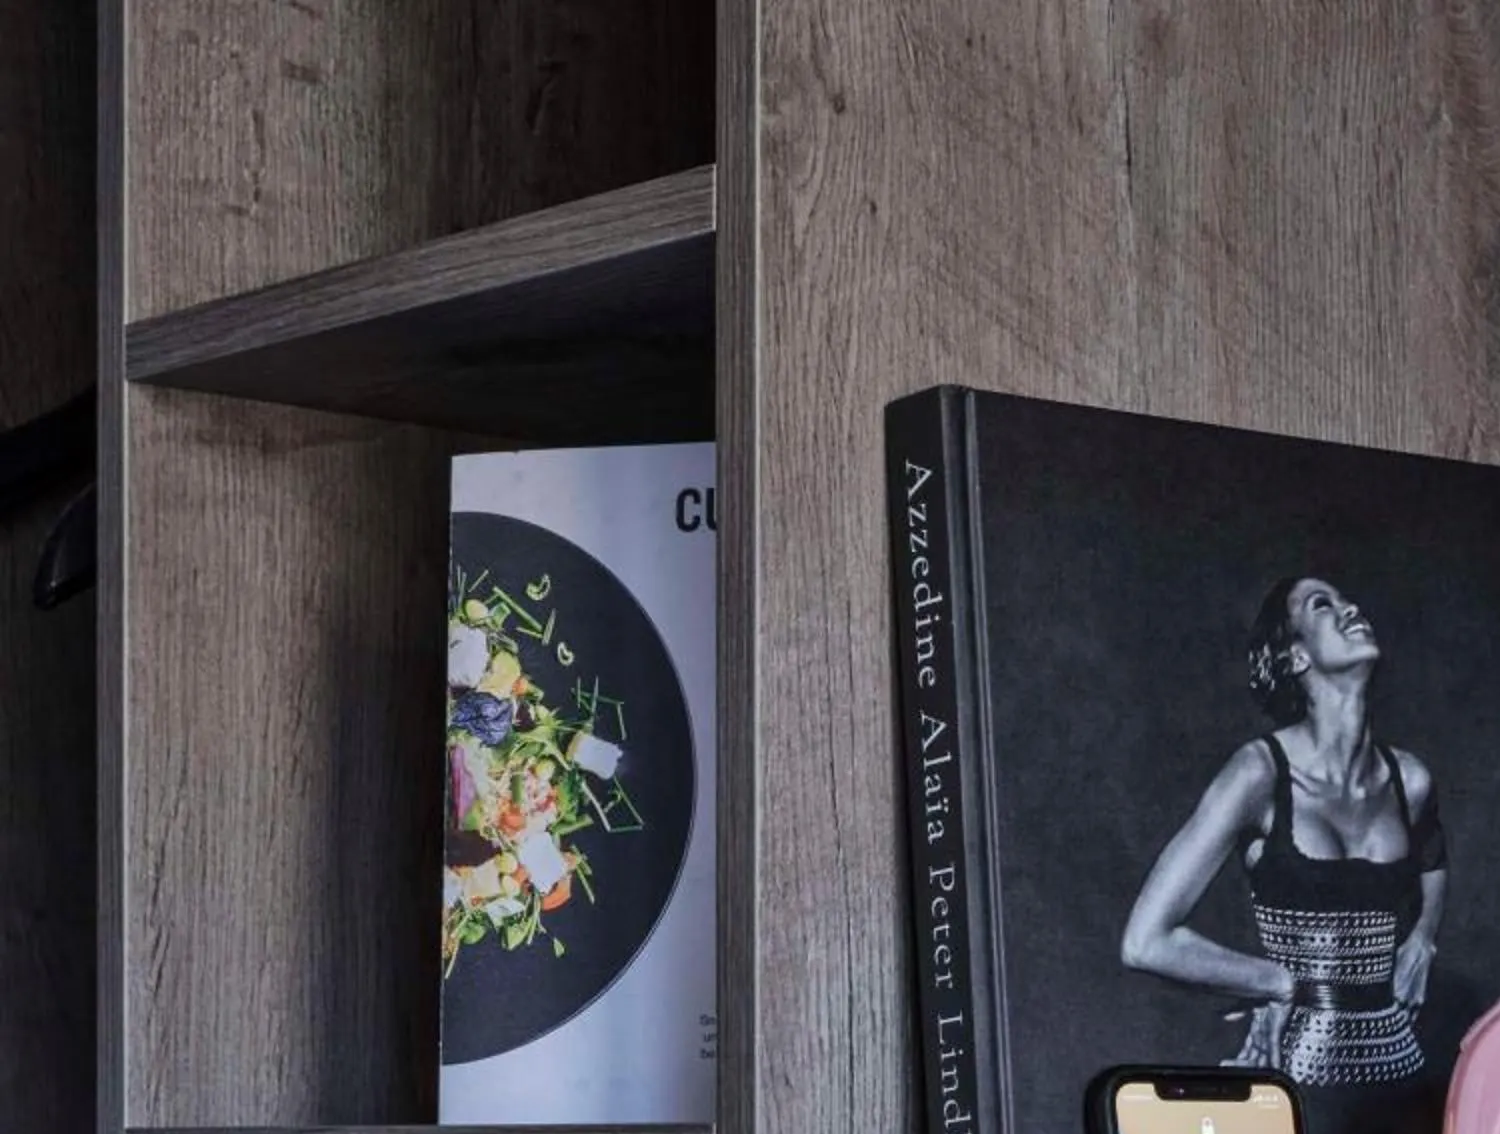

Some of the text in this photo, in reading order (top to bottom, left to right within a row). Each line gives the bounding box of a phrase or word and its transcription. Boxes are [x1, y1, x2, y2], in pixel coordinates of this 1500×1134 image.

[905, 458, 943, 689] Azzedine
[920, 710, 952, 846] Alaïa
[928, 861, 956, 991] Peter
